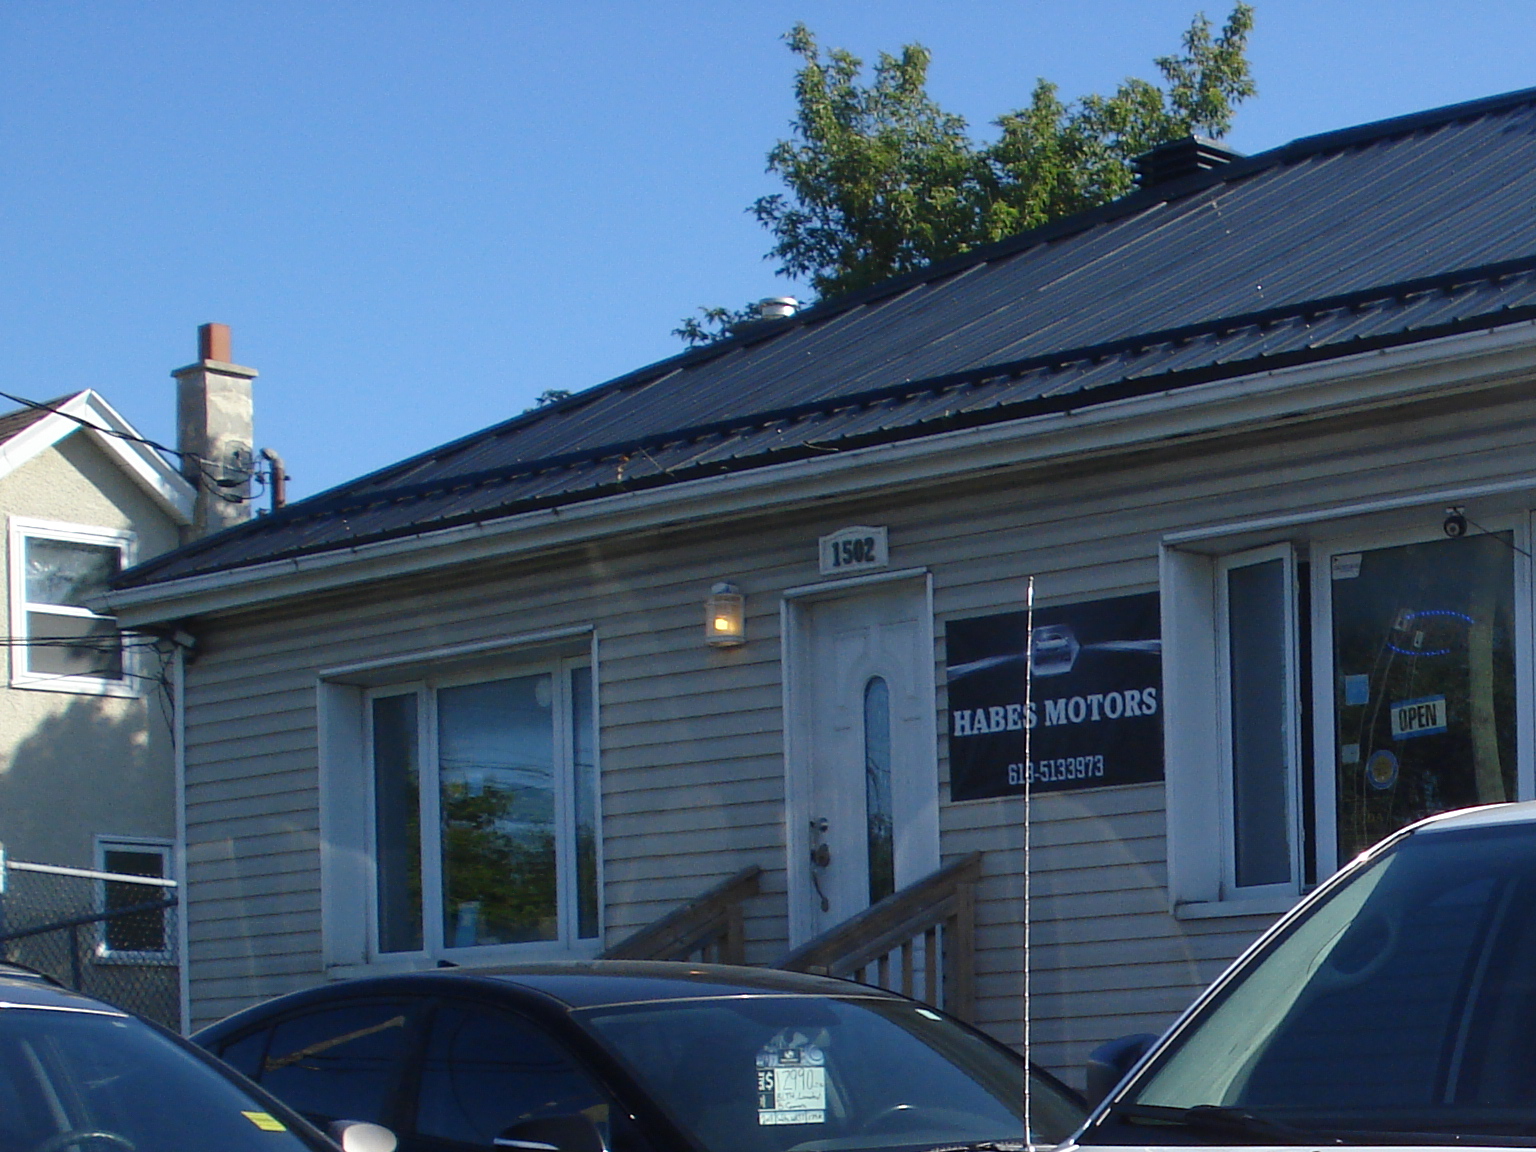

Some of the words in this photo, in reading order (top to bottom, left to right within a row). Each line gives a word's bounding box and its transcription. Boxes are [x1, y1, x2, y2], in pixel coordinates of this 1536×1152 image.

[831, 536, 875, 567] 1502
[953, 702, 1038, 737] HABES
[1044, 687, 1158, 727] MOTORS
[1397, 702, 1438, 732] OPEN
